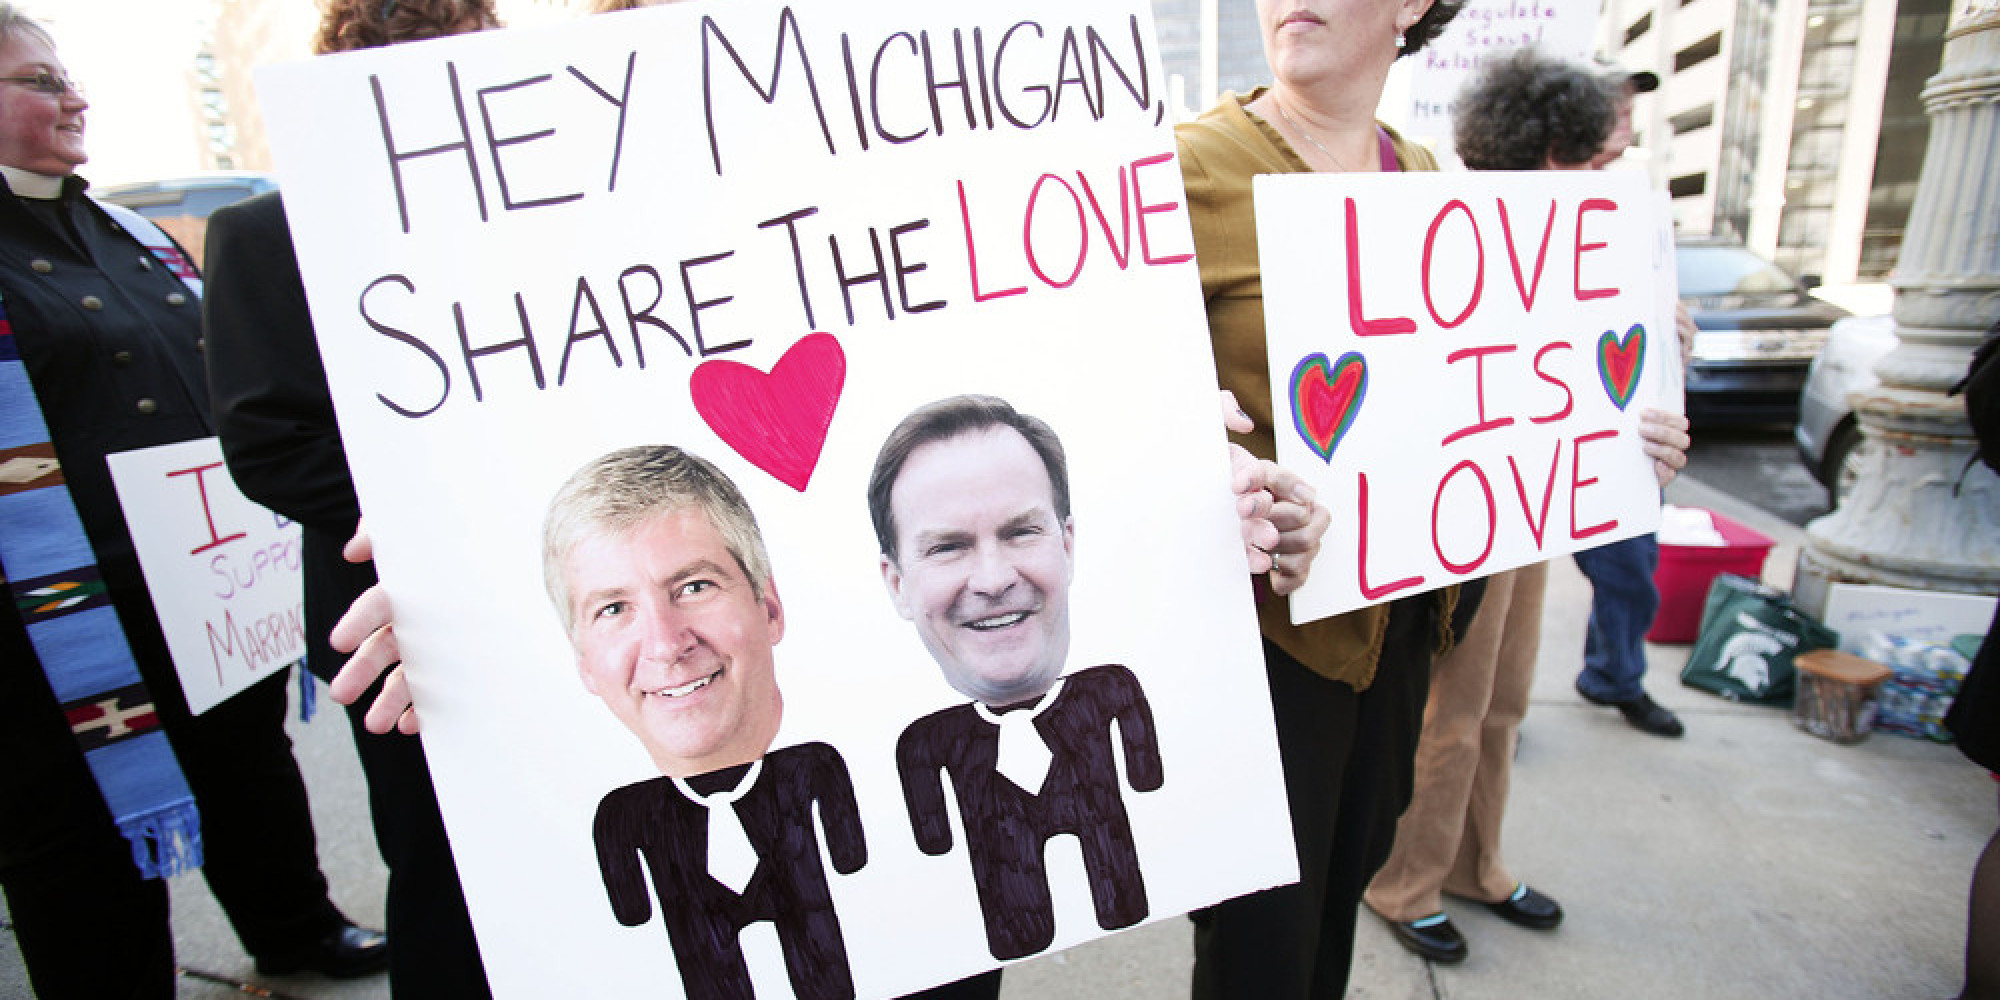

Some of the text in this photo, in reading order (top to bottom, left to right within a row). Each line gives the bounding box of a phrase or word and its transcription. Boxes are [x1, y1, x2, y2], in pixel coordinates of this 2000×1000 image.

[369, 6, 1164, 234] HEY MICHIGAN,
[359, 152, 1195, 418] SHARE THE LOVE
[1344, 197, 1620, 337] LOVE
[1441, 341, 1573, 447] IS
[166, 461, 247, 555] I
[1357, 429, 1620, 600] LOVE
